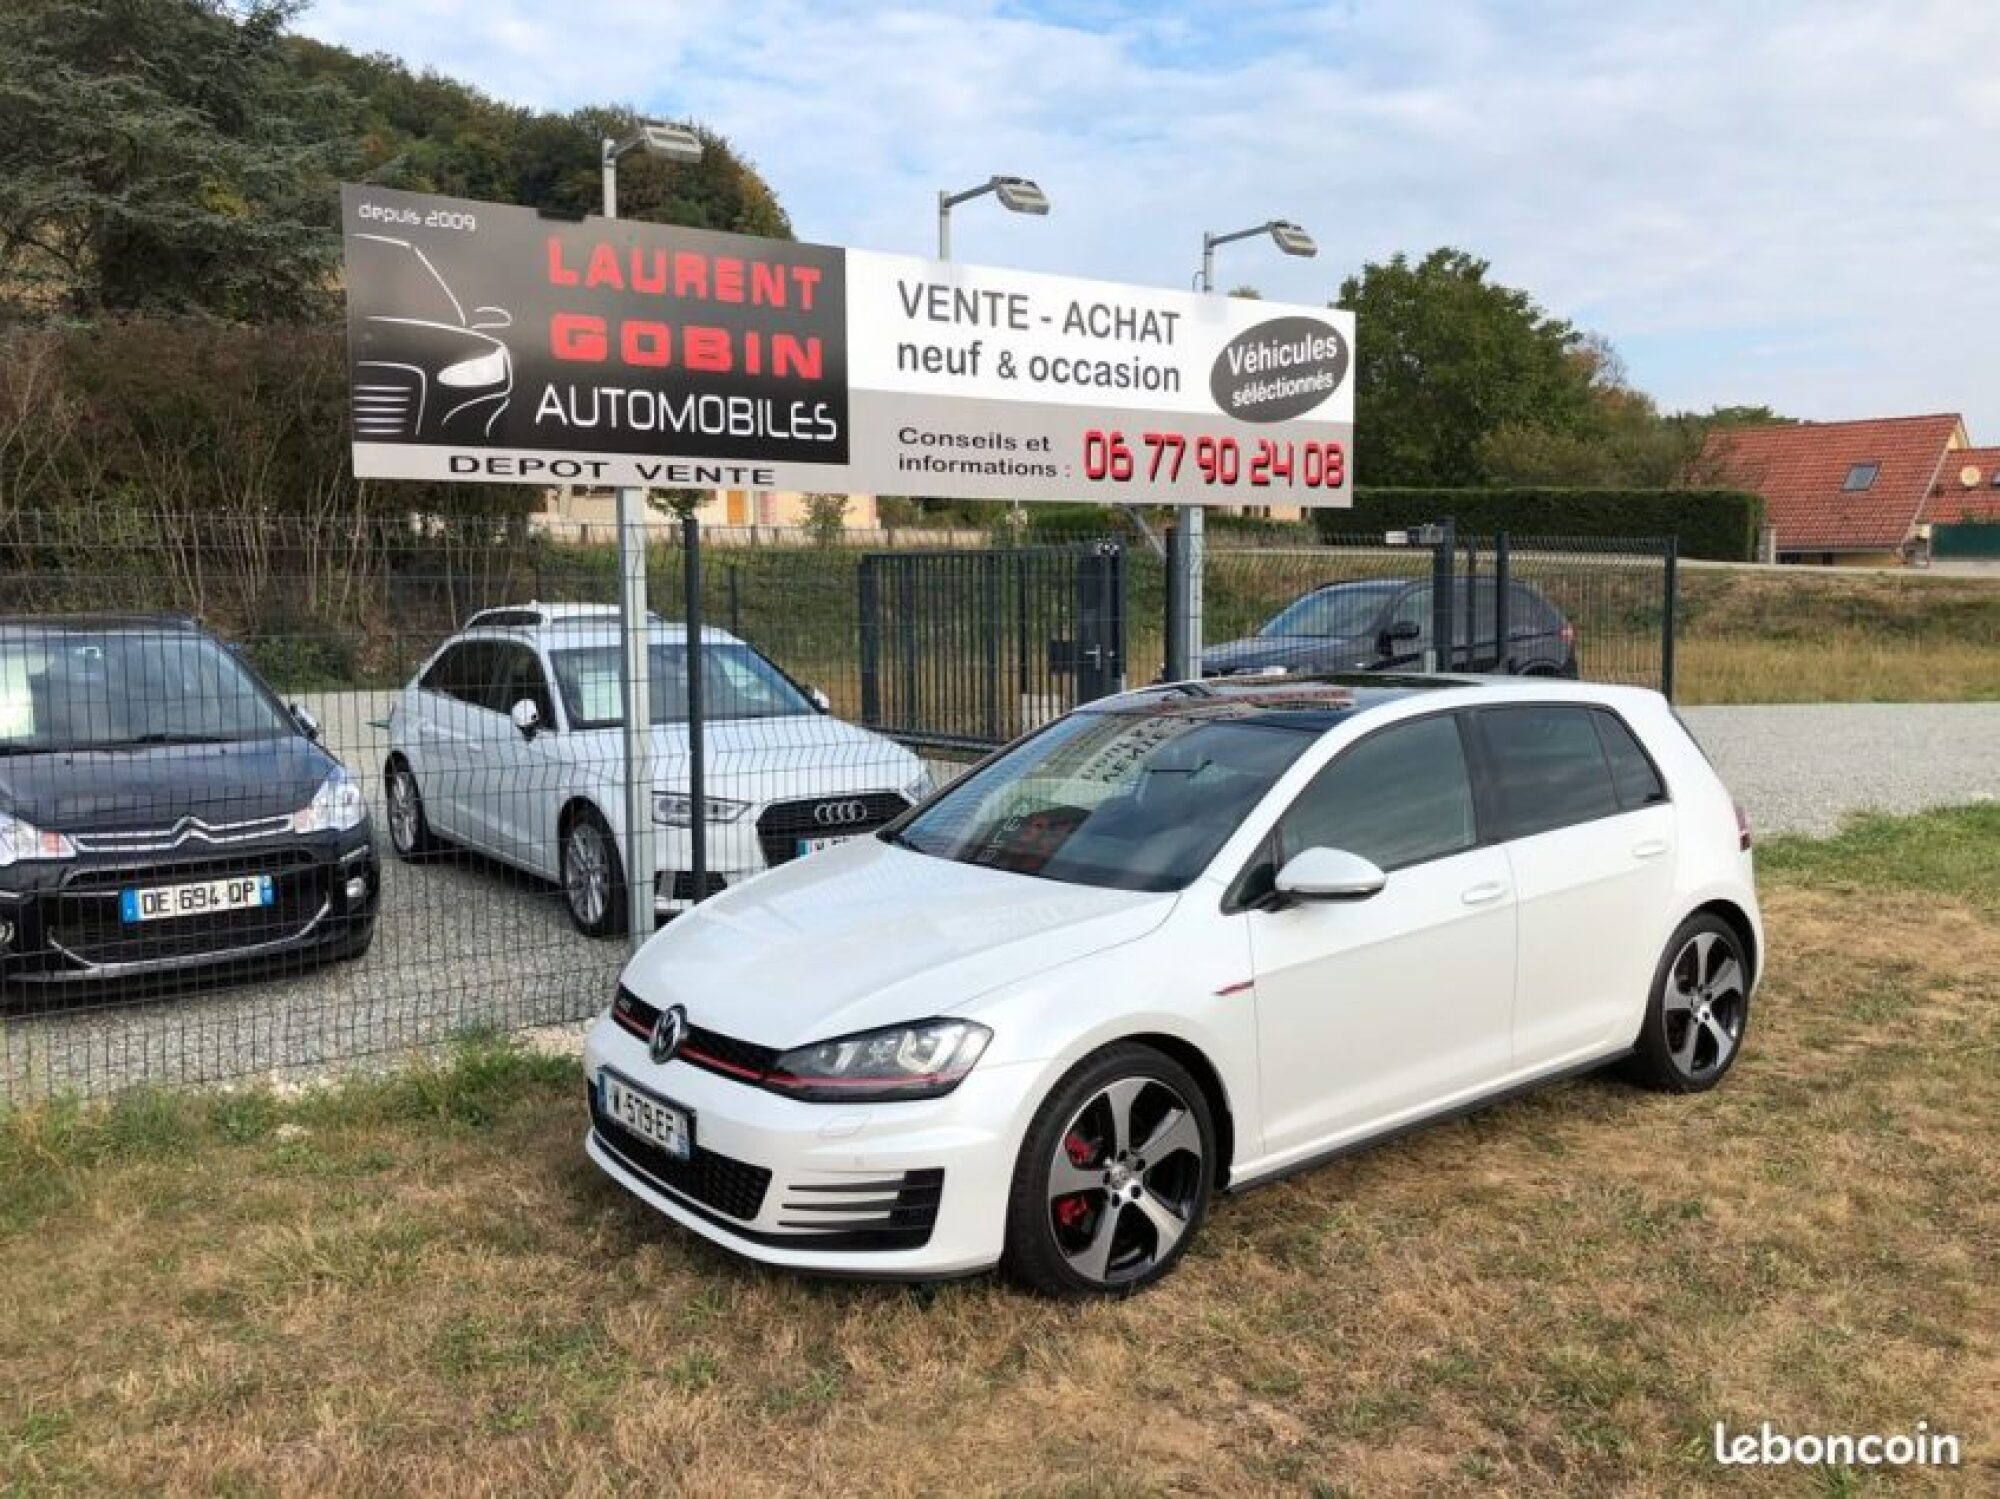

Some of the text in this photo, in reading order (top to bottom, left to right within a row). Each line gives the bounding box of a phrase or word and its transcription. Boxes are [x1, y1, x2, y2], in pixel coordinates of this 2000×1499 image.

[358, 200, 476, 232] depuis 2009
[547, 234, 822, 311] LAURENT
[897, 280, 1030, 330] VENTE
[1063, 299, 1181, 346] ACHAT
[550, 311, 823, 380] GOBIN
[897, 340, 1181, 393] neuf & occasion
[1227, 332, 1338, 376] Véhicules
[535, 382, 837, 441] AUTOMOBILES
[898, 426, 1051, 452] Conseils et
[899, 453, 1058, 478] informations
[1084, 430, 1344, 489] 06 77 90 24 08
[449, 455, 775, 485] DEPOT VENTE
